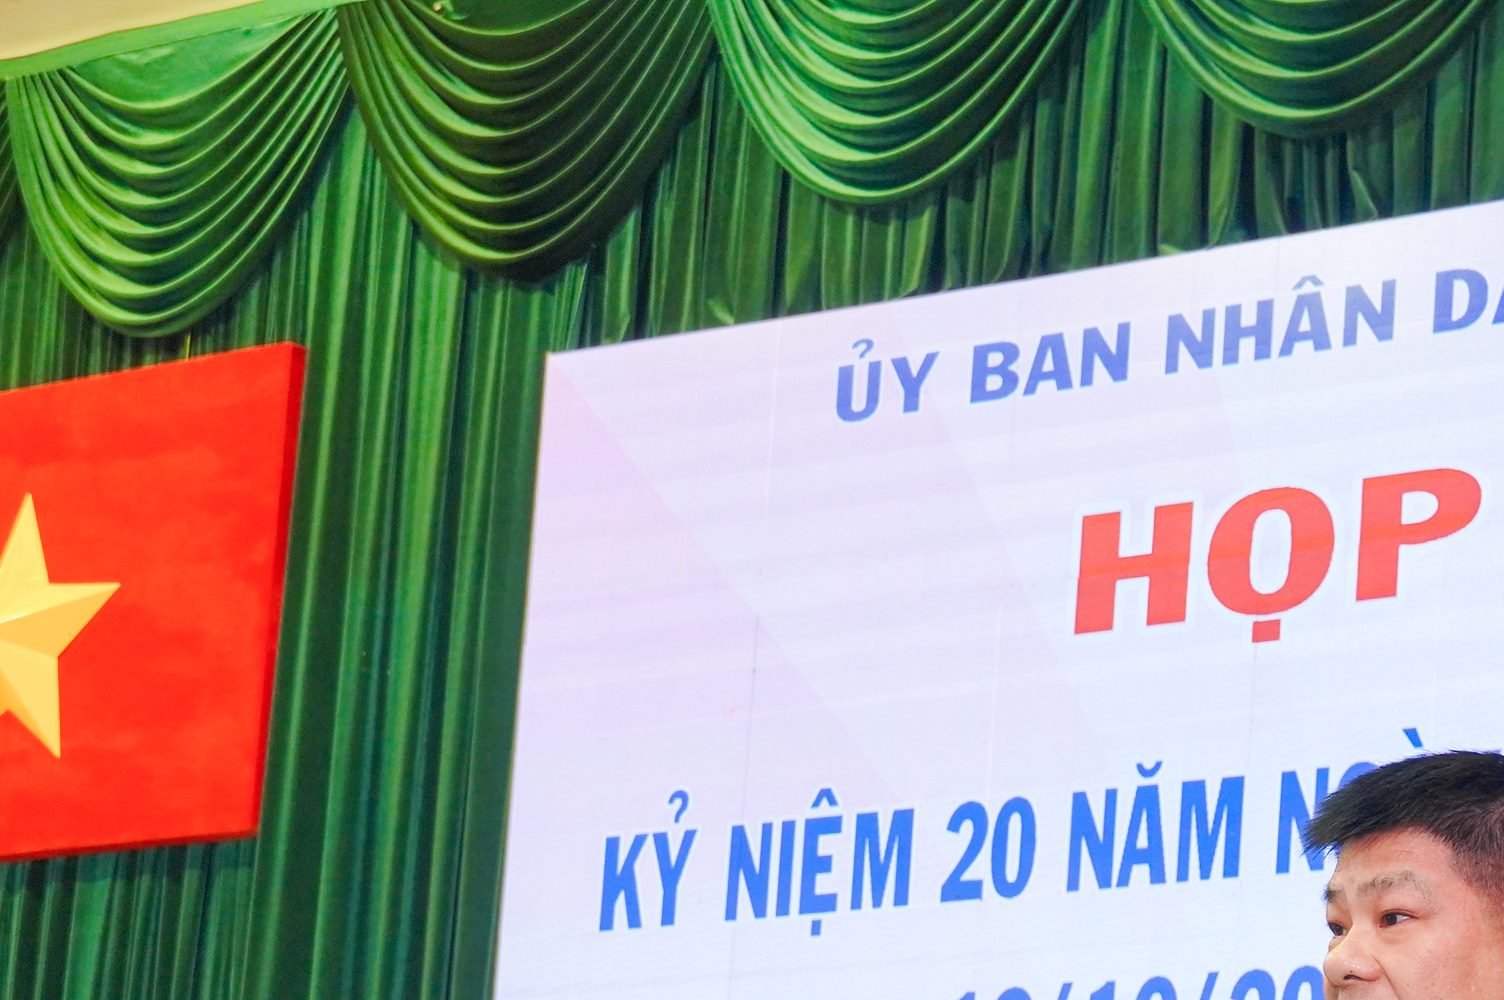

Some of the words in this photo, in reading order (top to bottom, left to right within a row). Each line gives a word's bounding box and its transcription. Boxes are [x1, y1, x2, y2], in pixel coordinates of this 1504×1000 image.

[835, 338, 939, 423] ỦY
[970, 322, 1131, 405] BAN
[1164, 276, 1397, 375] NHÂN
[1074, 468, 1483, 643] HỌP
[598, 789, 698, 933] KỶ
[724, 787, 915, 938] NIỆM
[940, 795, 1038, 904] 20
[1065, 759, 1246, 894] NĂM
